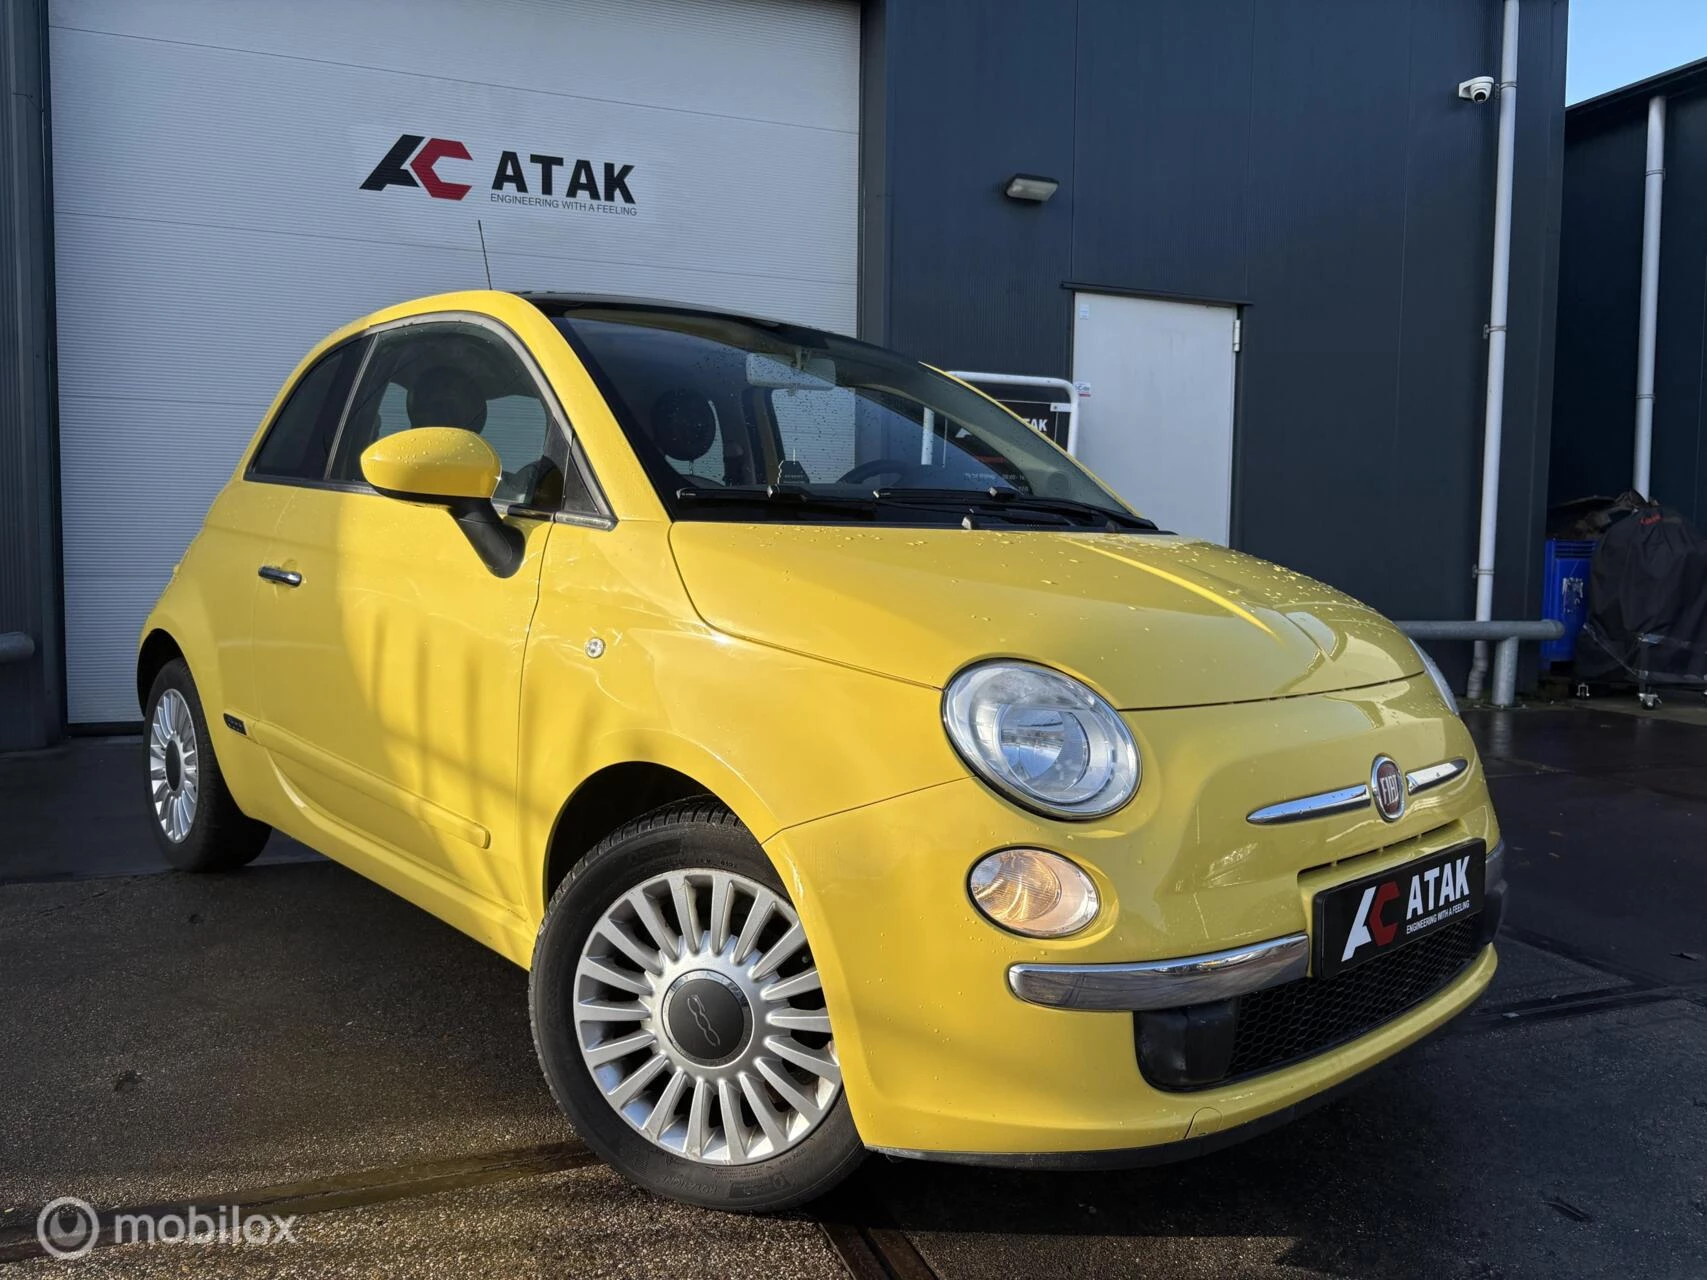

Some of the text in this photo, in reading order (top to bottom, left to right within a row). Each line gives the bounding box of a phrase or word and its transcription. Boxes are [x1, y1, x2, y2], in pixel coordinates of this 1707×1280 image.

[491, 150, 636, 205] ATAK
[490, 193, 638, 217] ENGINEERING WITH A FEELING
[1380, 774, 1399, 806] FIAT
[1406, 855, 1471, 920] ATAK
[1406, 913, 1438, 934] ENGINEERING
[1437, 908, 1449, 921] WITH
[1452, 899, 1470, 914] FEELING
